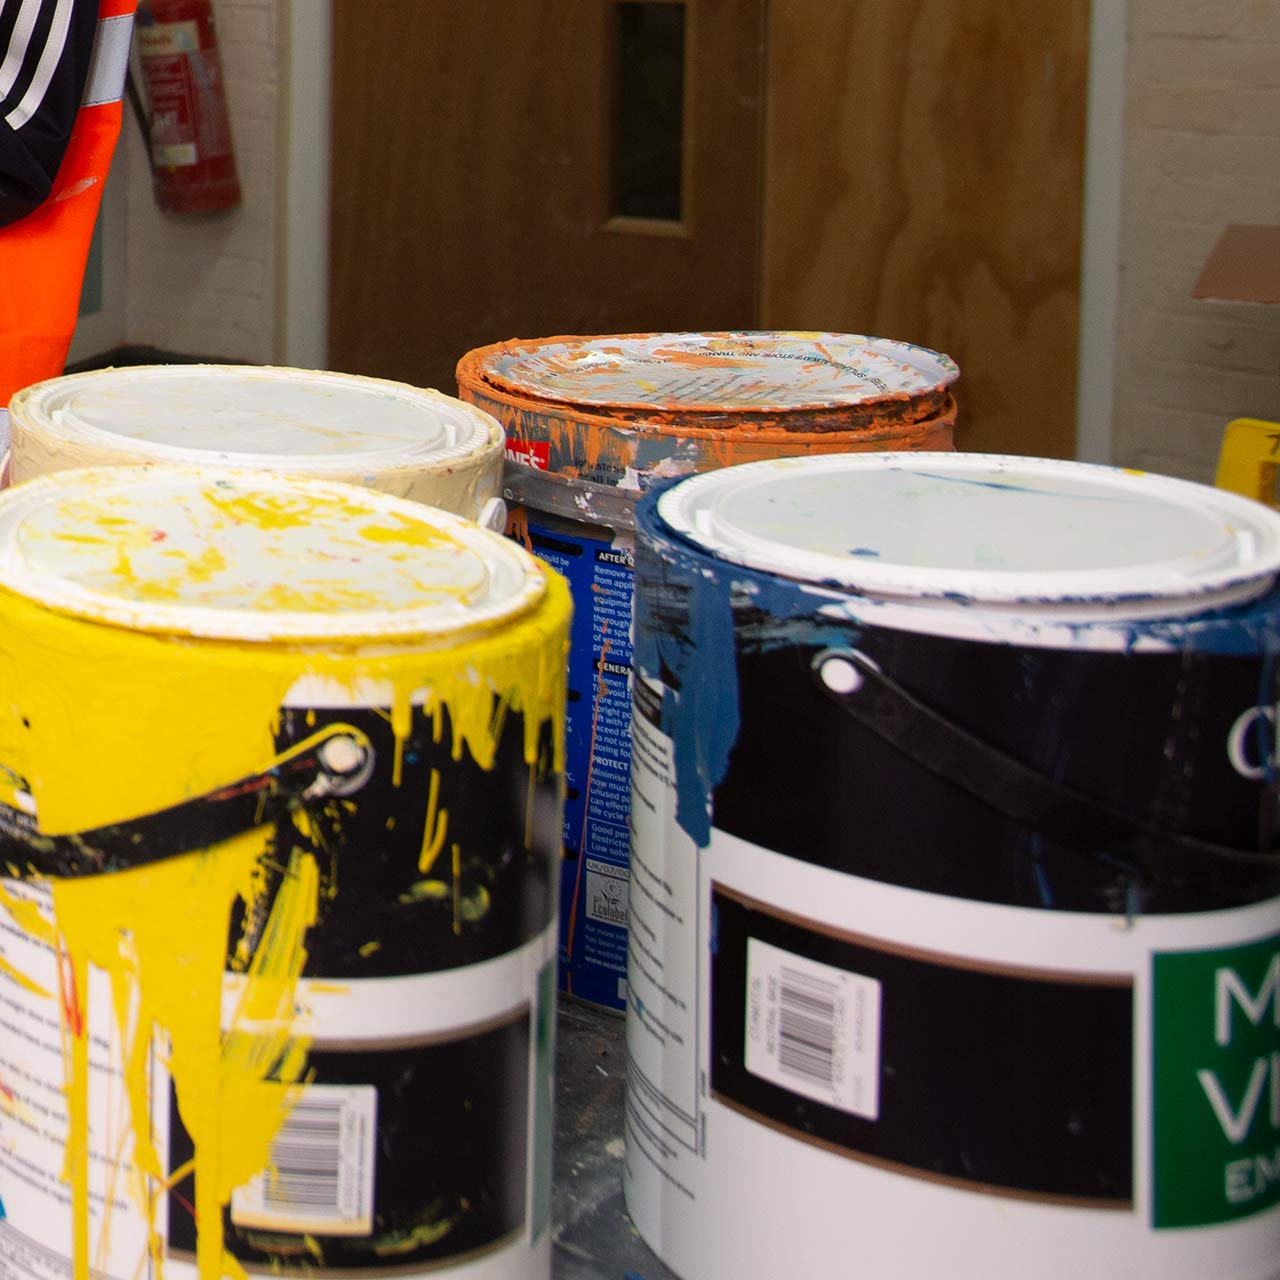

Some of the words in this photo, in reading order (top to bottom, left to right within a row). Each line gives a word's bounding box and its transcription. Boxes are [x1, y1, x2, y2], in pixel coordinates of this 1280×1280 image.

[598, 552, 625, 563] AFTER
[594, 565, 626, 578] Remove
[594, 574, 613, 585] from
[594, 605, 616, 616] warm
[593, 624, 612, 634] hae
[593, 643, 624, 657] prduct
[592, 694, 612, 705] sore
[614, 698, 629, 708] and
[606, 716, 623, 727] with
[604, 735, 617, 745] not
[591, 767, 627, 782] Minimise
[591, 777, 608, 787] how
[590, 786, 621, 800] unused
[590, 796, 605, 806] can
[591, 823, 613, 836] Good
[591, 842, 608, 853] Low
